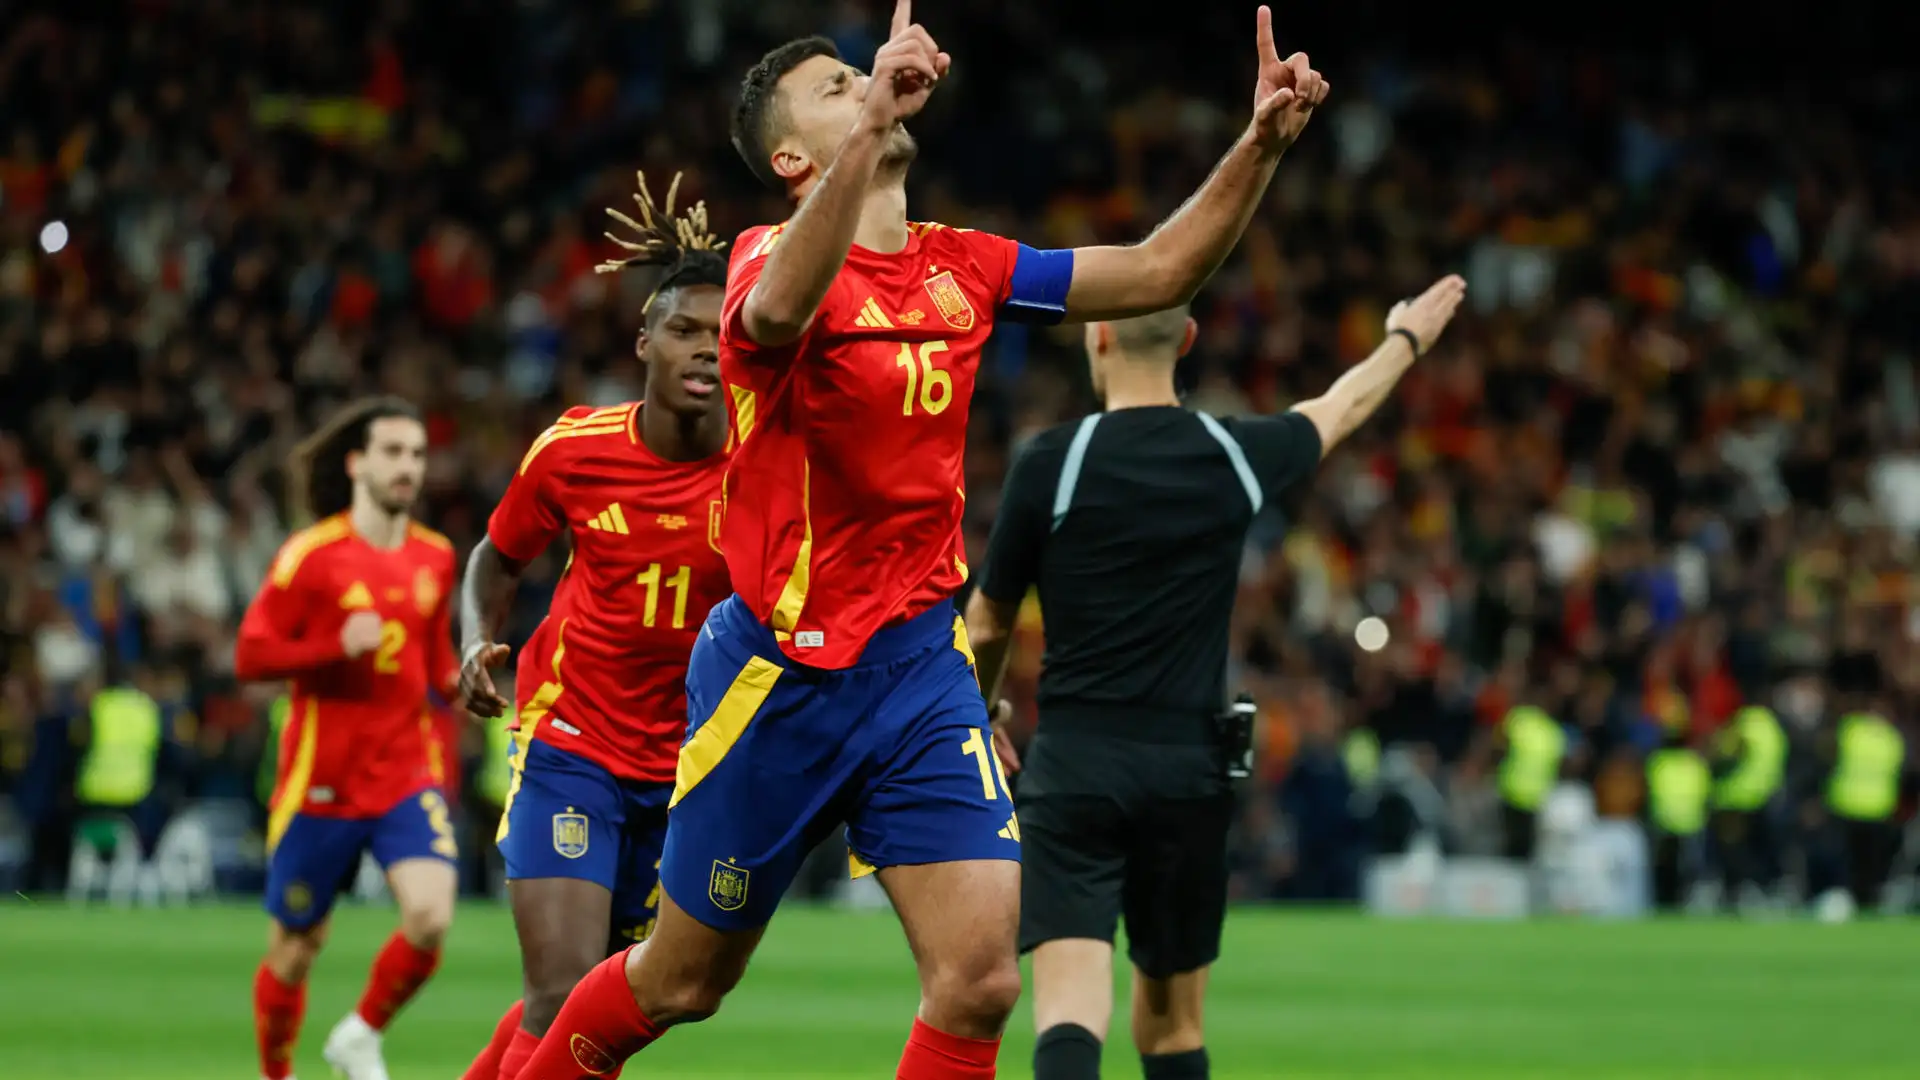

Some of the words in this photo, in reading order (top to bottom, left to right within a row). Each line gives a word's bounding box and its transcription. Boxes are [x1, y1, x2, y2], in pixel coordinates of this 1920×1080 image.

[896, 340, 953, 416] 16
[636, 562, 692, 629] 11
[961, 727, 1014, 805] 1
